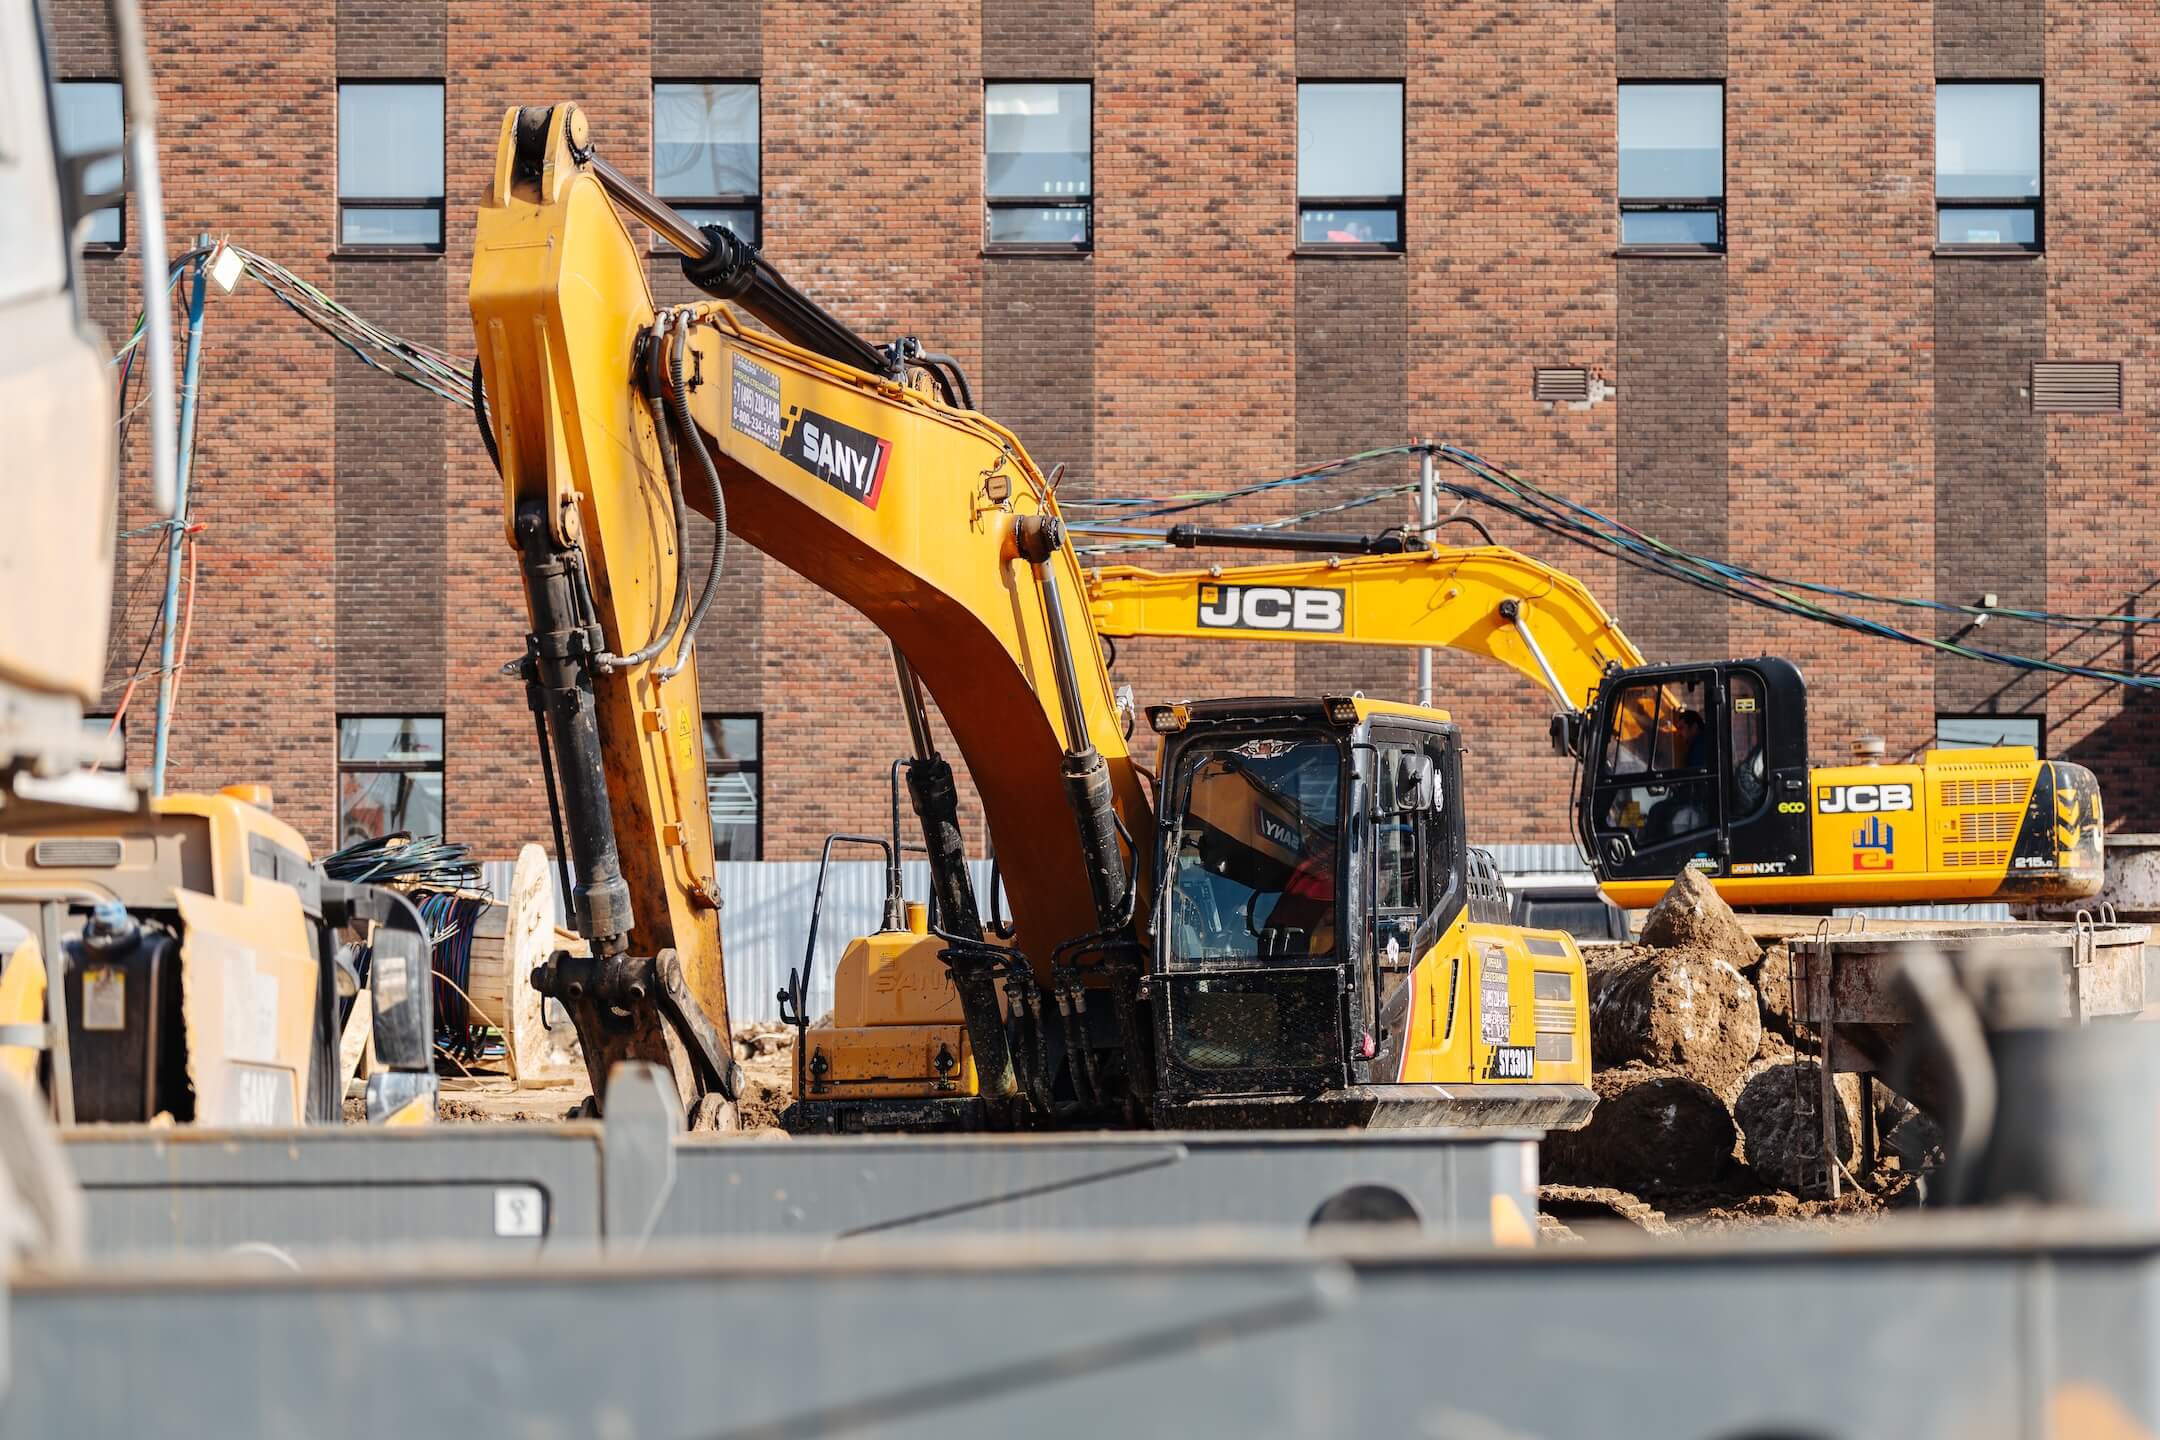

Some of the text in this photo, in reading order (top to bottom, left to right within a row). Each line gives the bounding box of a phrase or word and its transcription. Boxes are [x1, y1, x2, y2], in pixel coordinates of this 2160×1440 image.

[803, 421, 867, 490] SANY
[1200, 586, 1342, 630] JCB
[1778, 802, 1805, 813] eco
[1820, 784, 1912, 813] JCB
[1753, 862, 1787, 874] NXT
